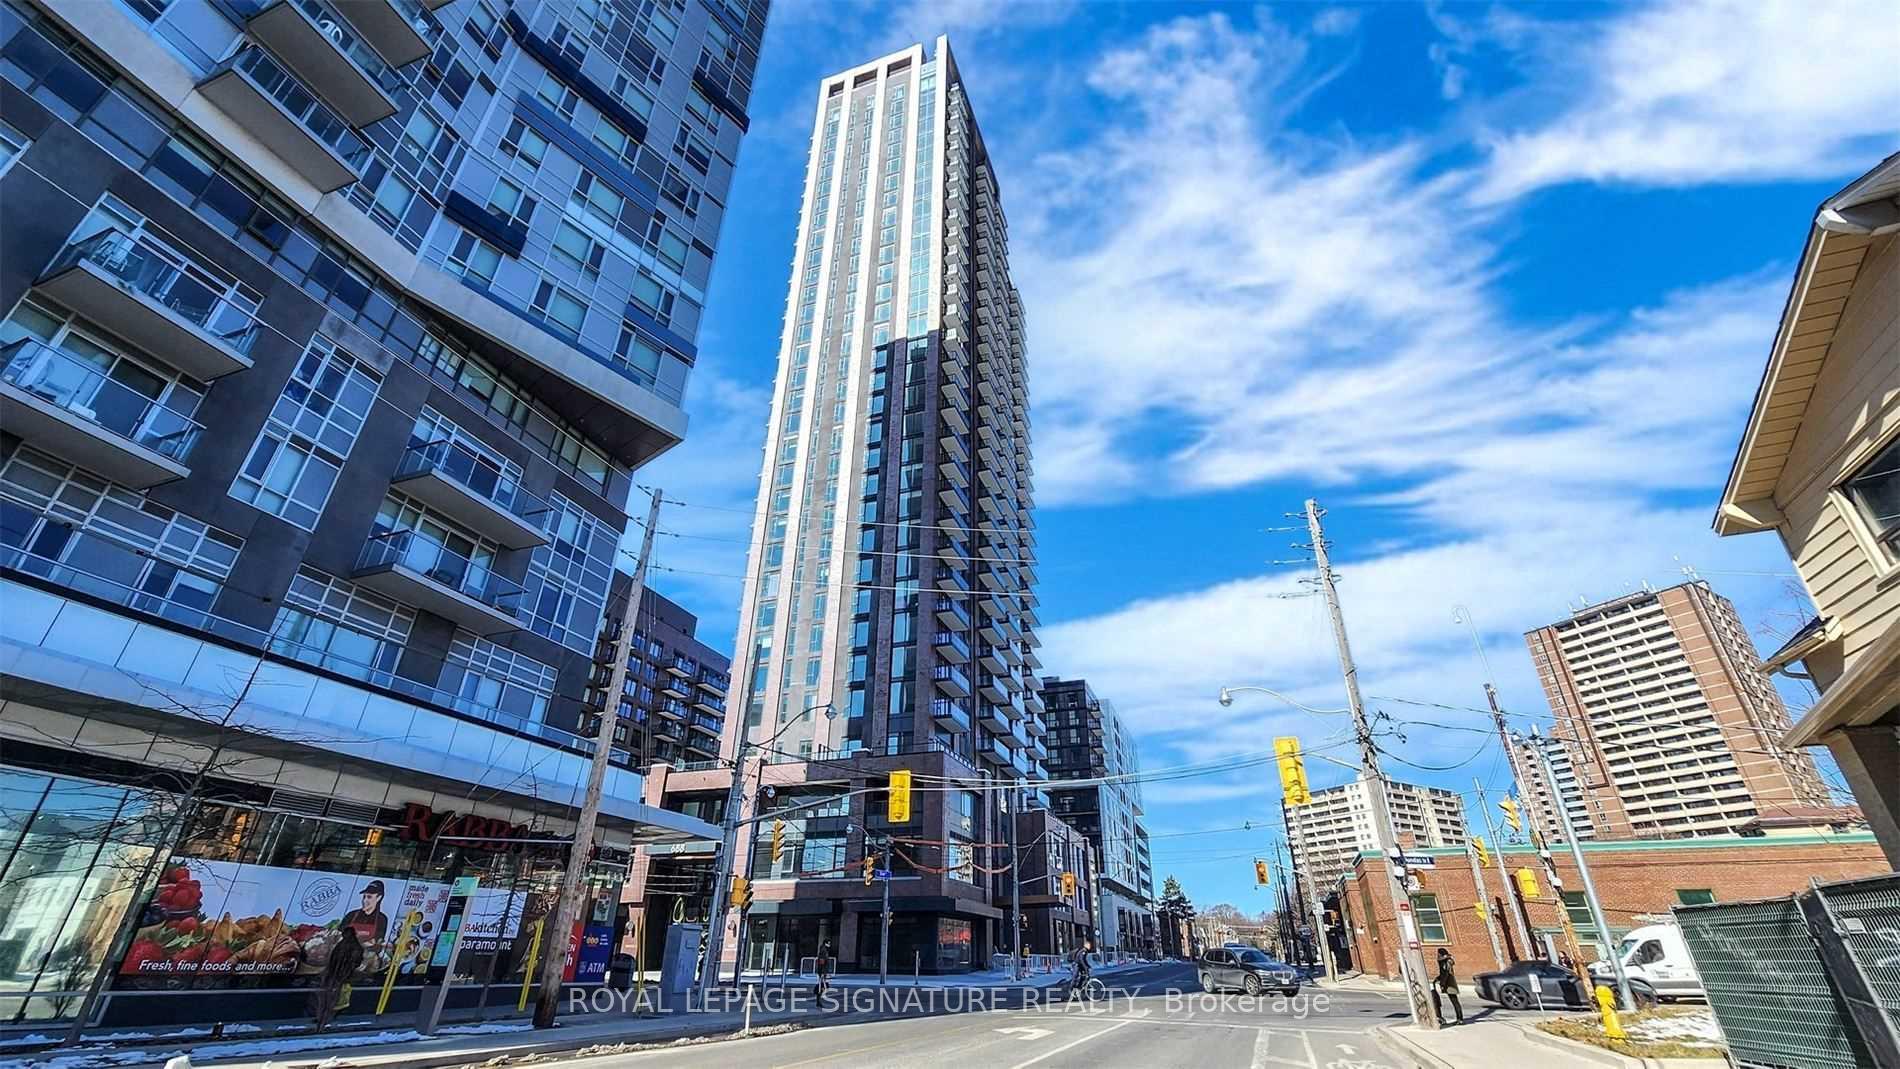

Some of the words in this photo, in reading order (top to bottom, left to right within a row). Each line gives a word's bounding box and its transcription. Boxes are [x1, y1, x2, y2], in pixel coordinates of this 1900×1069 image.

[409, 884, 429, 892] made
[404, 899, 423, 908] daily
[138, 960, 174, 972] Fresh,
[176, 960, 198, 971] fine
[200, 960, 232, 971] foods
[235, 961, 256, 971] and
[587, 961, 605, 974] ATM
